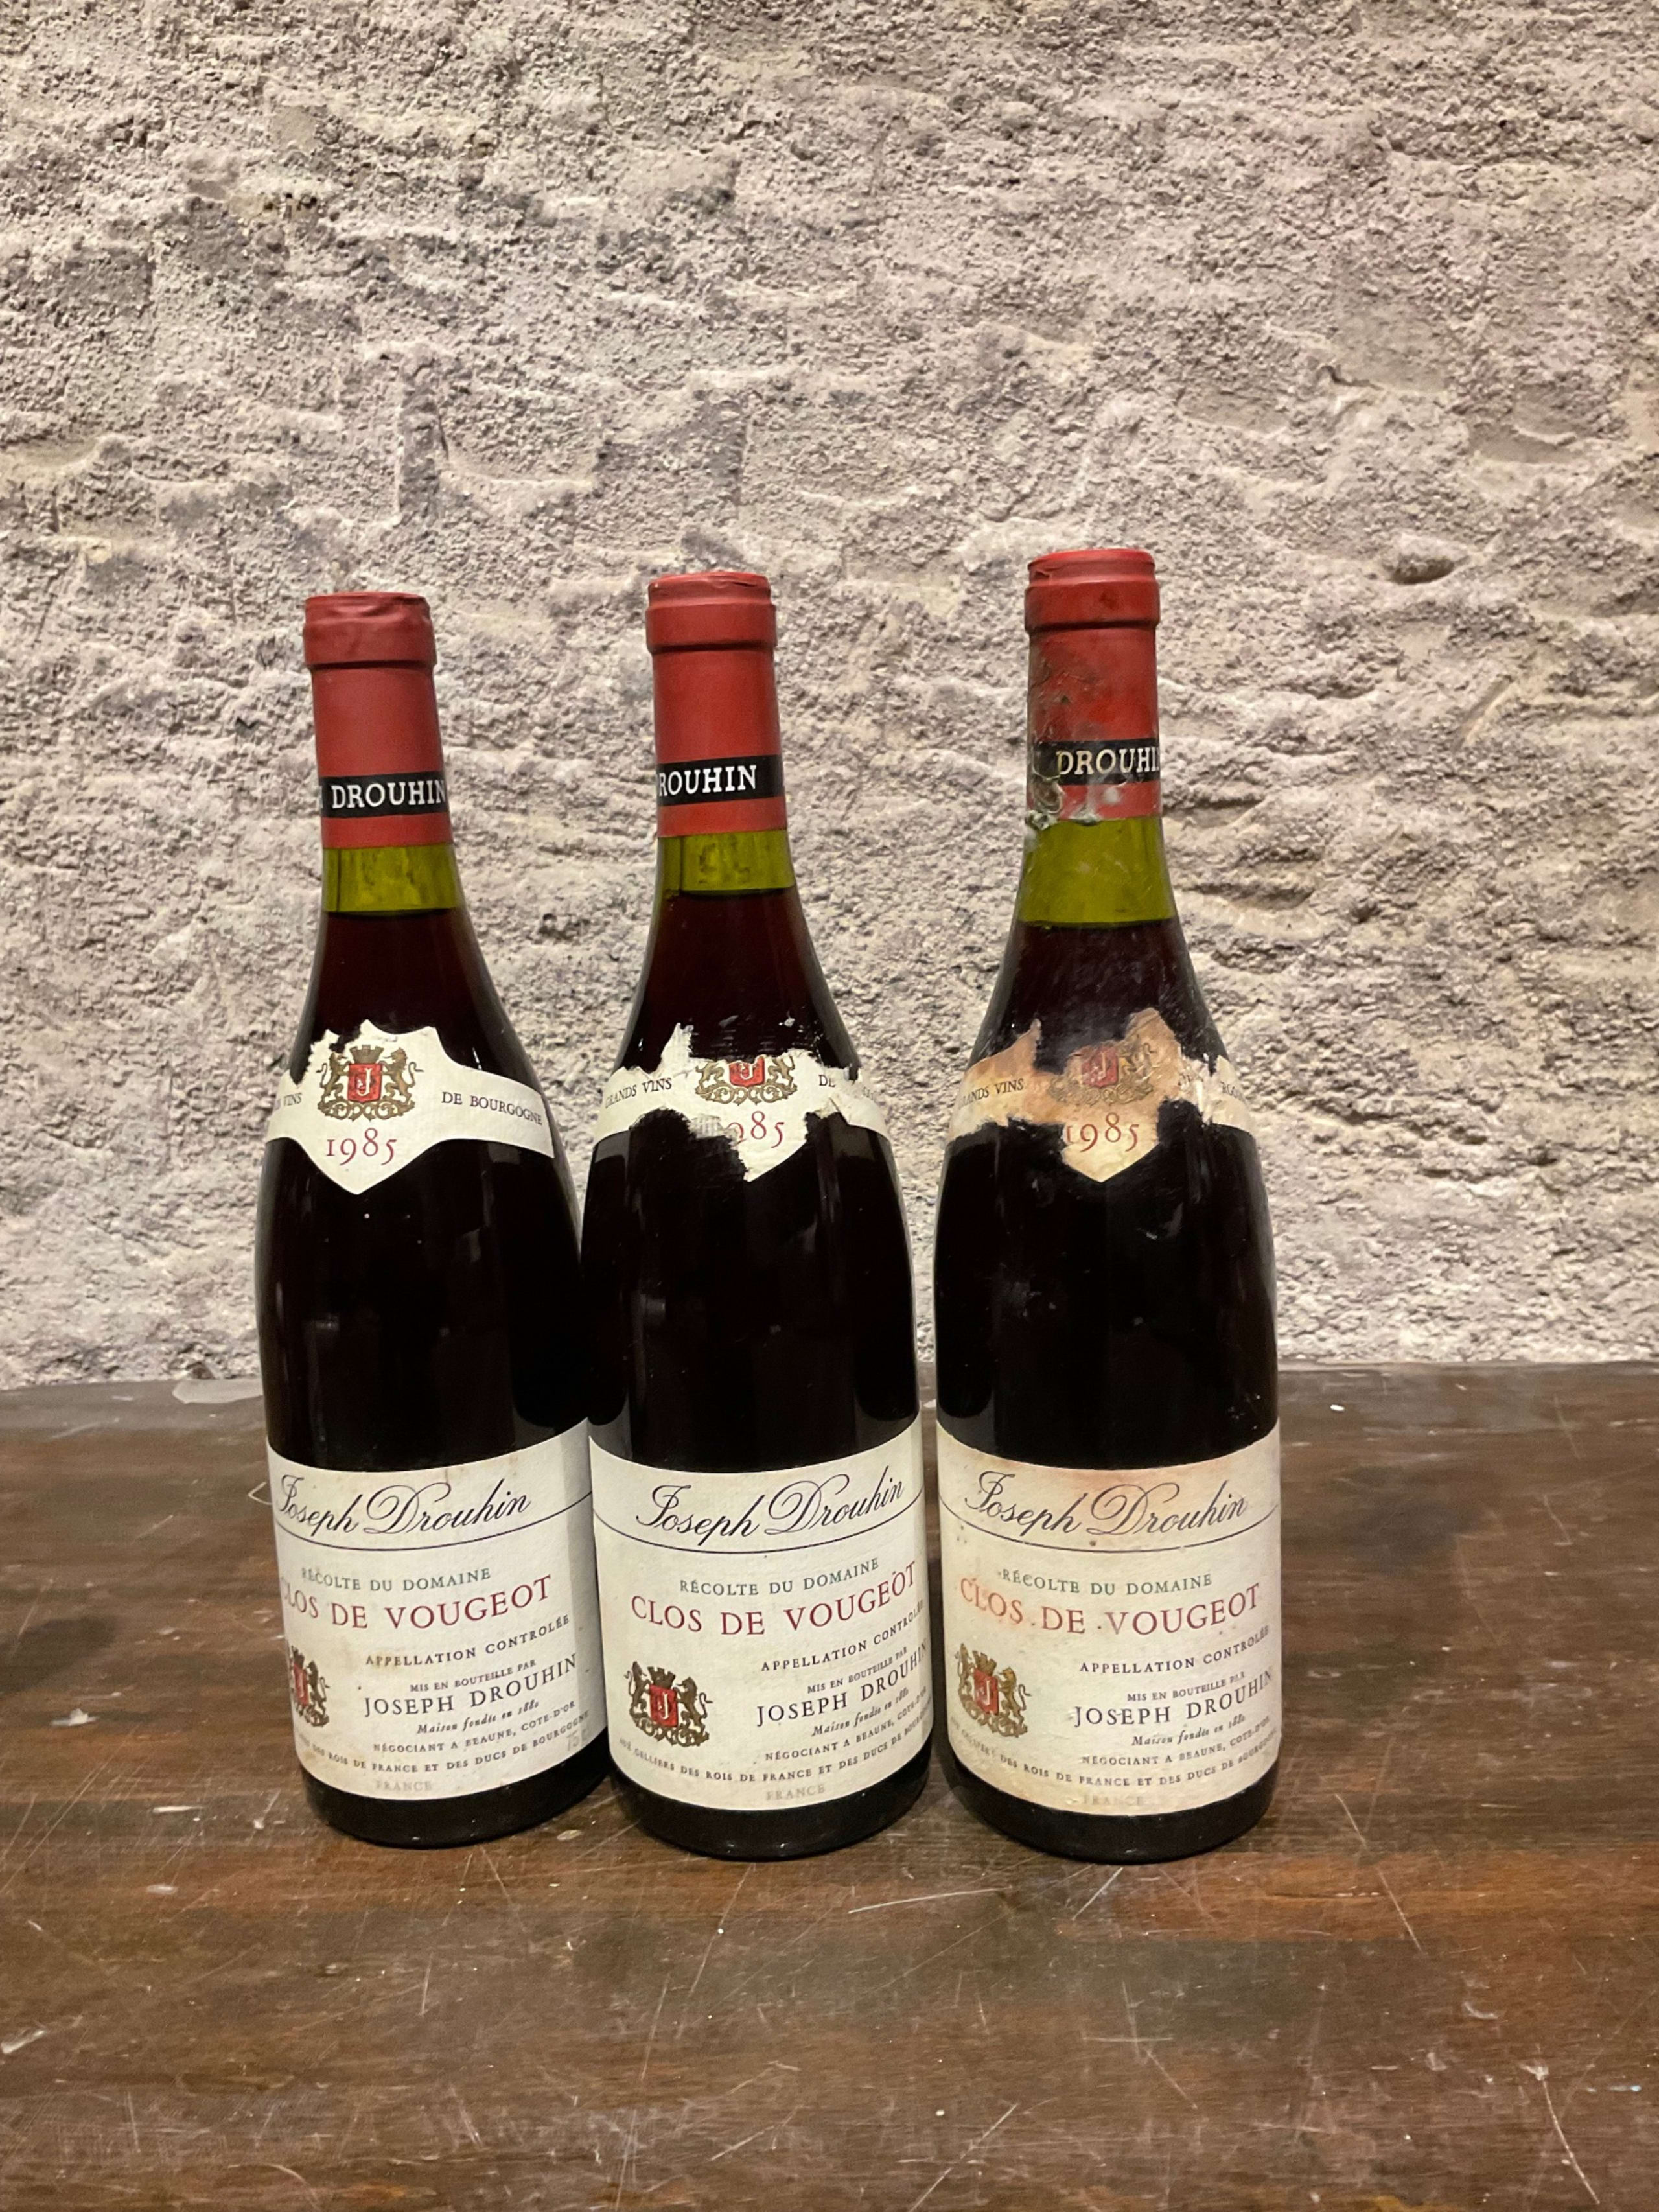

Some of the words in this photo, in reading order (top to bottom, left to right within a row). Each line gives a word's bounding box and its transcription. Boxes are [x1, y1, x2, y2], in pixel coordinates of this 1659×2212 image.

[1056, 746, 1160, 775] DROUHI
[331, 779, 445, 809] DROUHIN
[657, 765, 756, 797] ROUHIN
[642, 1077, 672, 1093] VINS
[994, 1078, 1024, 1095] VINS
[441, 1091, 463, 1105] DE
[470, 1095, 542, 1126] BOURGOGNE
[327, 1128, 397, 1165] 1985
[1066, 1112, 1139, 1152] 1985
[279, 1474, 363, 1537] Joseph
[363, 1478, 531, 1534] Drouhin
[636, 1484, 765, 1546] Joseph
[764, 1465, 904, 1535] Drouhin
[964, 1471, 1089, 1537] Joseph
[1086, 1480, 1249, 1535] Drouhin
[370, 1579, 392, 1592] DU
[403, 1567, 491, 1591] DOMAINE
[680, 1579, 759, 1596] RÉCOLTE
[769, 1580, 793, 1594] DU
[804, 1557, 879, 1590] DOMAINE
[1003, 1568, 1080, 1594] RÉCOLTE
[1091, 1582, 1115, 1596] DU
[1126, 1573, 1212, 1595] DOMAINE
[331, 1601, 368, 1629] DE
[384, 1574, 551, 1629] VOUGEOT
[631, 1595, 702, 1633] CLOS
[720, 1611, 765, 1636] DE
[783, 1560, 916, 1631] VOUGEOT
[960, 1578, 1023, 1624] CLOS
[1041, 1605, 1085, 1635] DE
[1104, 1582, 1259, 1636] VOUGEOT
[365, 1647, 476, 1666] APPELLATION
[485, 1614, 570, 1654] CONTROLÉE
[761, 1640, 867, 1671] APPELLATION
[410, 1683, 430, 1693] MIS
[434, 1681, 448, 1691] EN
[454, 1667, 513, 1688] BOUTEILLE
[517, 1659, 537, 1673] PAR
[1079, 1657, 1195, 1674] APPELLATION
[364, 1695, 455, 1718] JOSEPH
[469, 1653, 577, 1708] DROUHIN
[756, 1692, 848, 1727] JOSEPH
[861, 1638, 927, 1702] DROUHIN
[807, 1682, 826, 1694] MIS
[830, 1677, 844, 1689] EN
[1074, 1706, 1171, 1728] JOSEPH
[1186, 1666, 1272, 1719] DROUHIN
[1127, 1693, 1147, 1702] MIS
[1152, 1692, 1167, 1701] EN
[417, 1722, 458, 1734] Maison
[353, 1759, 367, 1769] DE
[372, 1763, 418, 1773] FRANCE
[424, 1763, 439, 1773] ET
[446, 1758, 469, 1770] DES
[474, 1749, 507, 1765] DUCS
[512, 1743, 528, 1755] DE
[680, 1765, 700, 1777] DES
[706, 1770, 733, 1781] ROIS
[739, 1773, 756, 1782] DE
[762, 1768, 812, 1782] FRANCE
[818, 1764, 833, 1775] ET
[839, 1756, 859, 1770] DES
[863, 1742, 888, 1760] DUCS
[765, 1741, 839, 1762] NÉGOCIANT
[844, 1738, 850, 1747] A
[1165, 1754, 1173, 1764] A
[1023, 1764, 1049, 1778] ROIS
[1056, 1771, 1072, 1782] DE
[1079, 1775, 1130, 1786] FRANCE
[1137, 1777, 1152, 1786] ET
[1159, 1774, 1181, 1786] DES
[1187, 1765, 1216, 1780] DUCS
[765, 1784, 826, 1801] FRANCE
